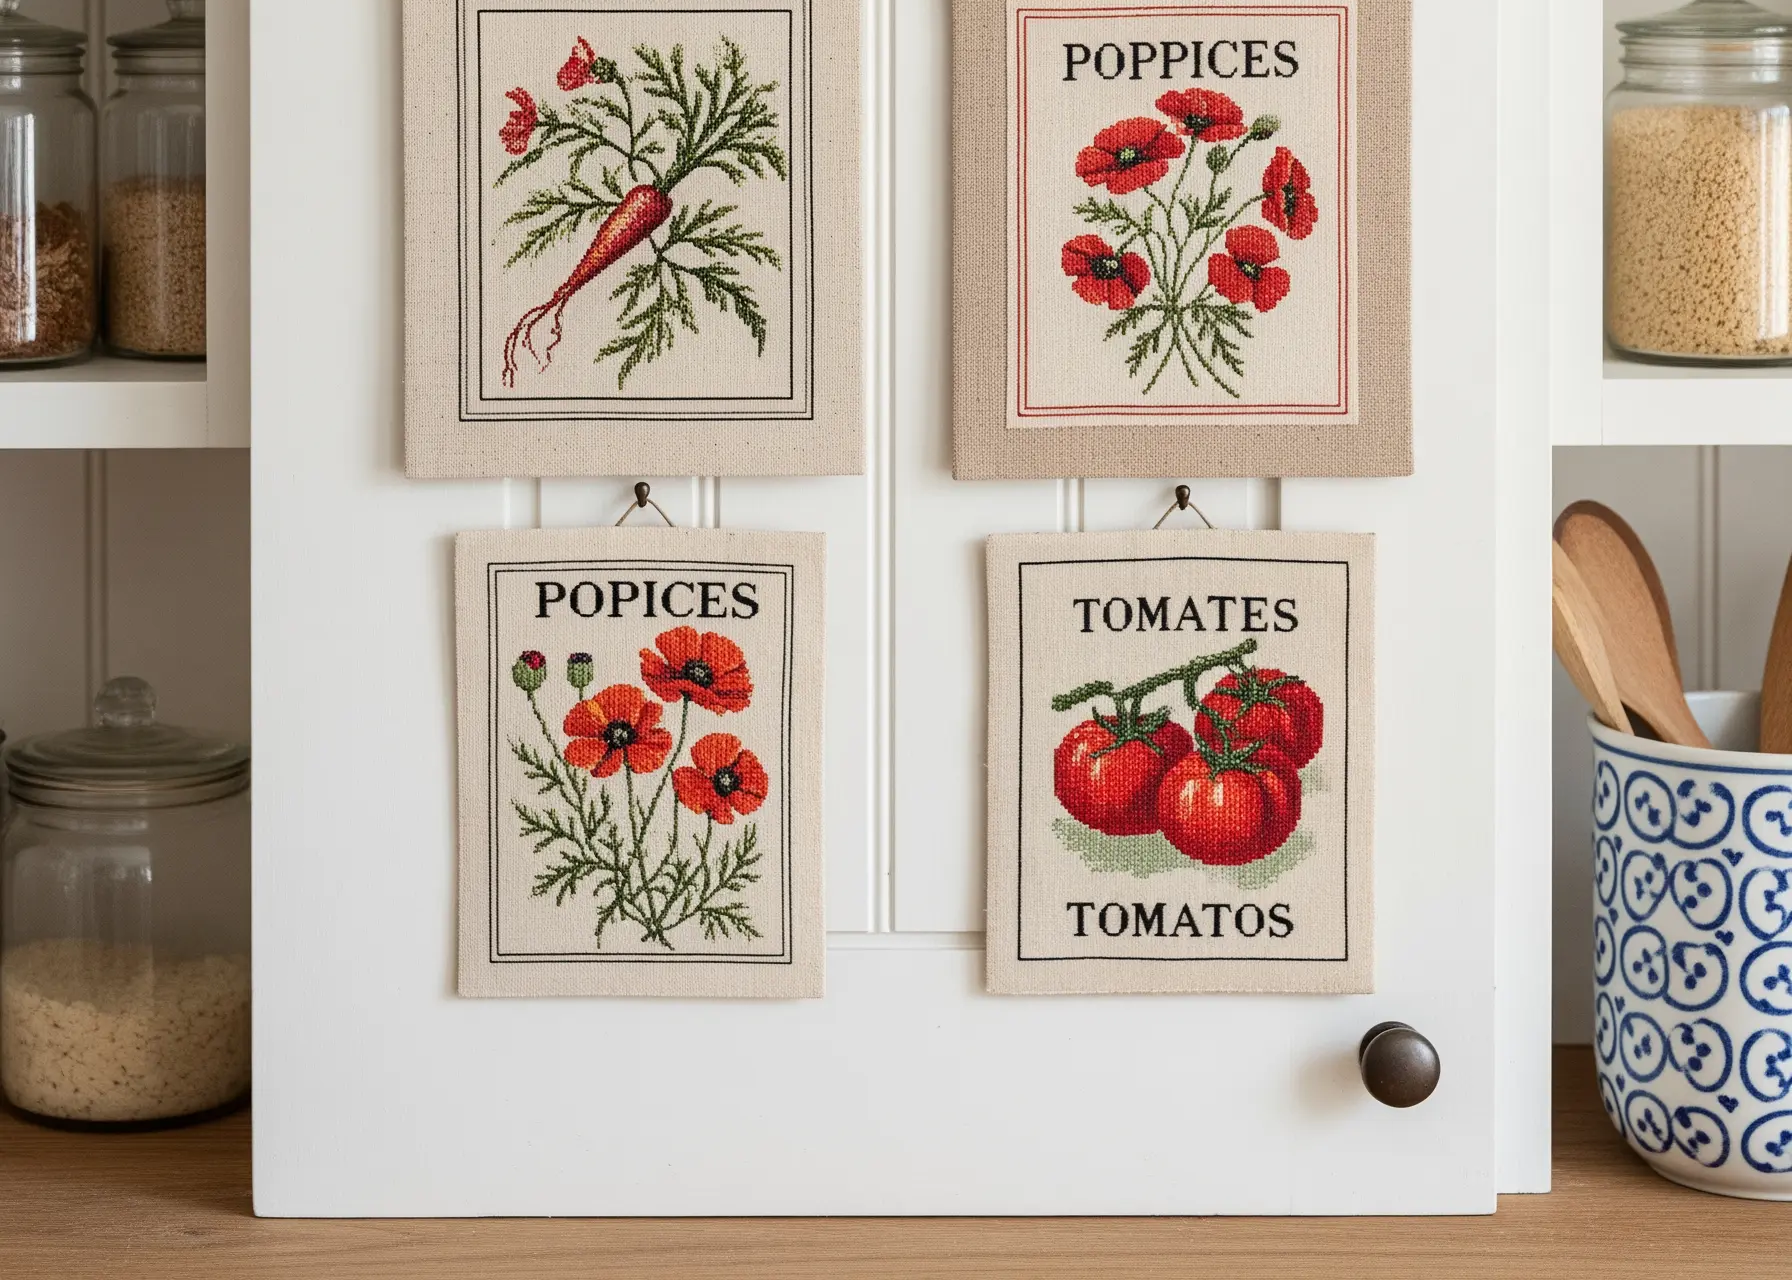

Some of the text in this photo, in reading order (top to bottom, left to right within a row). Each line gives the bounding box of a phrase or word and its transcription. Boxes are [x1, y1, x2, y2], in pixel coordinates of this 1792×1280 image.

[1062, 40, 1300, 81] POPPICES
[534, 580, 760, 620] POPICES
[1072, 595, 1299, 635] TOMATES
[1066, 901, 1295, 939] TOMATOS
